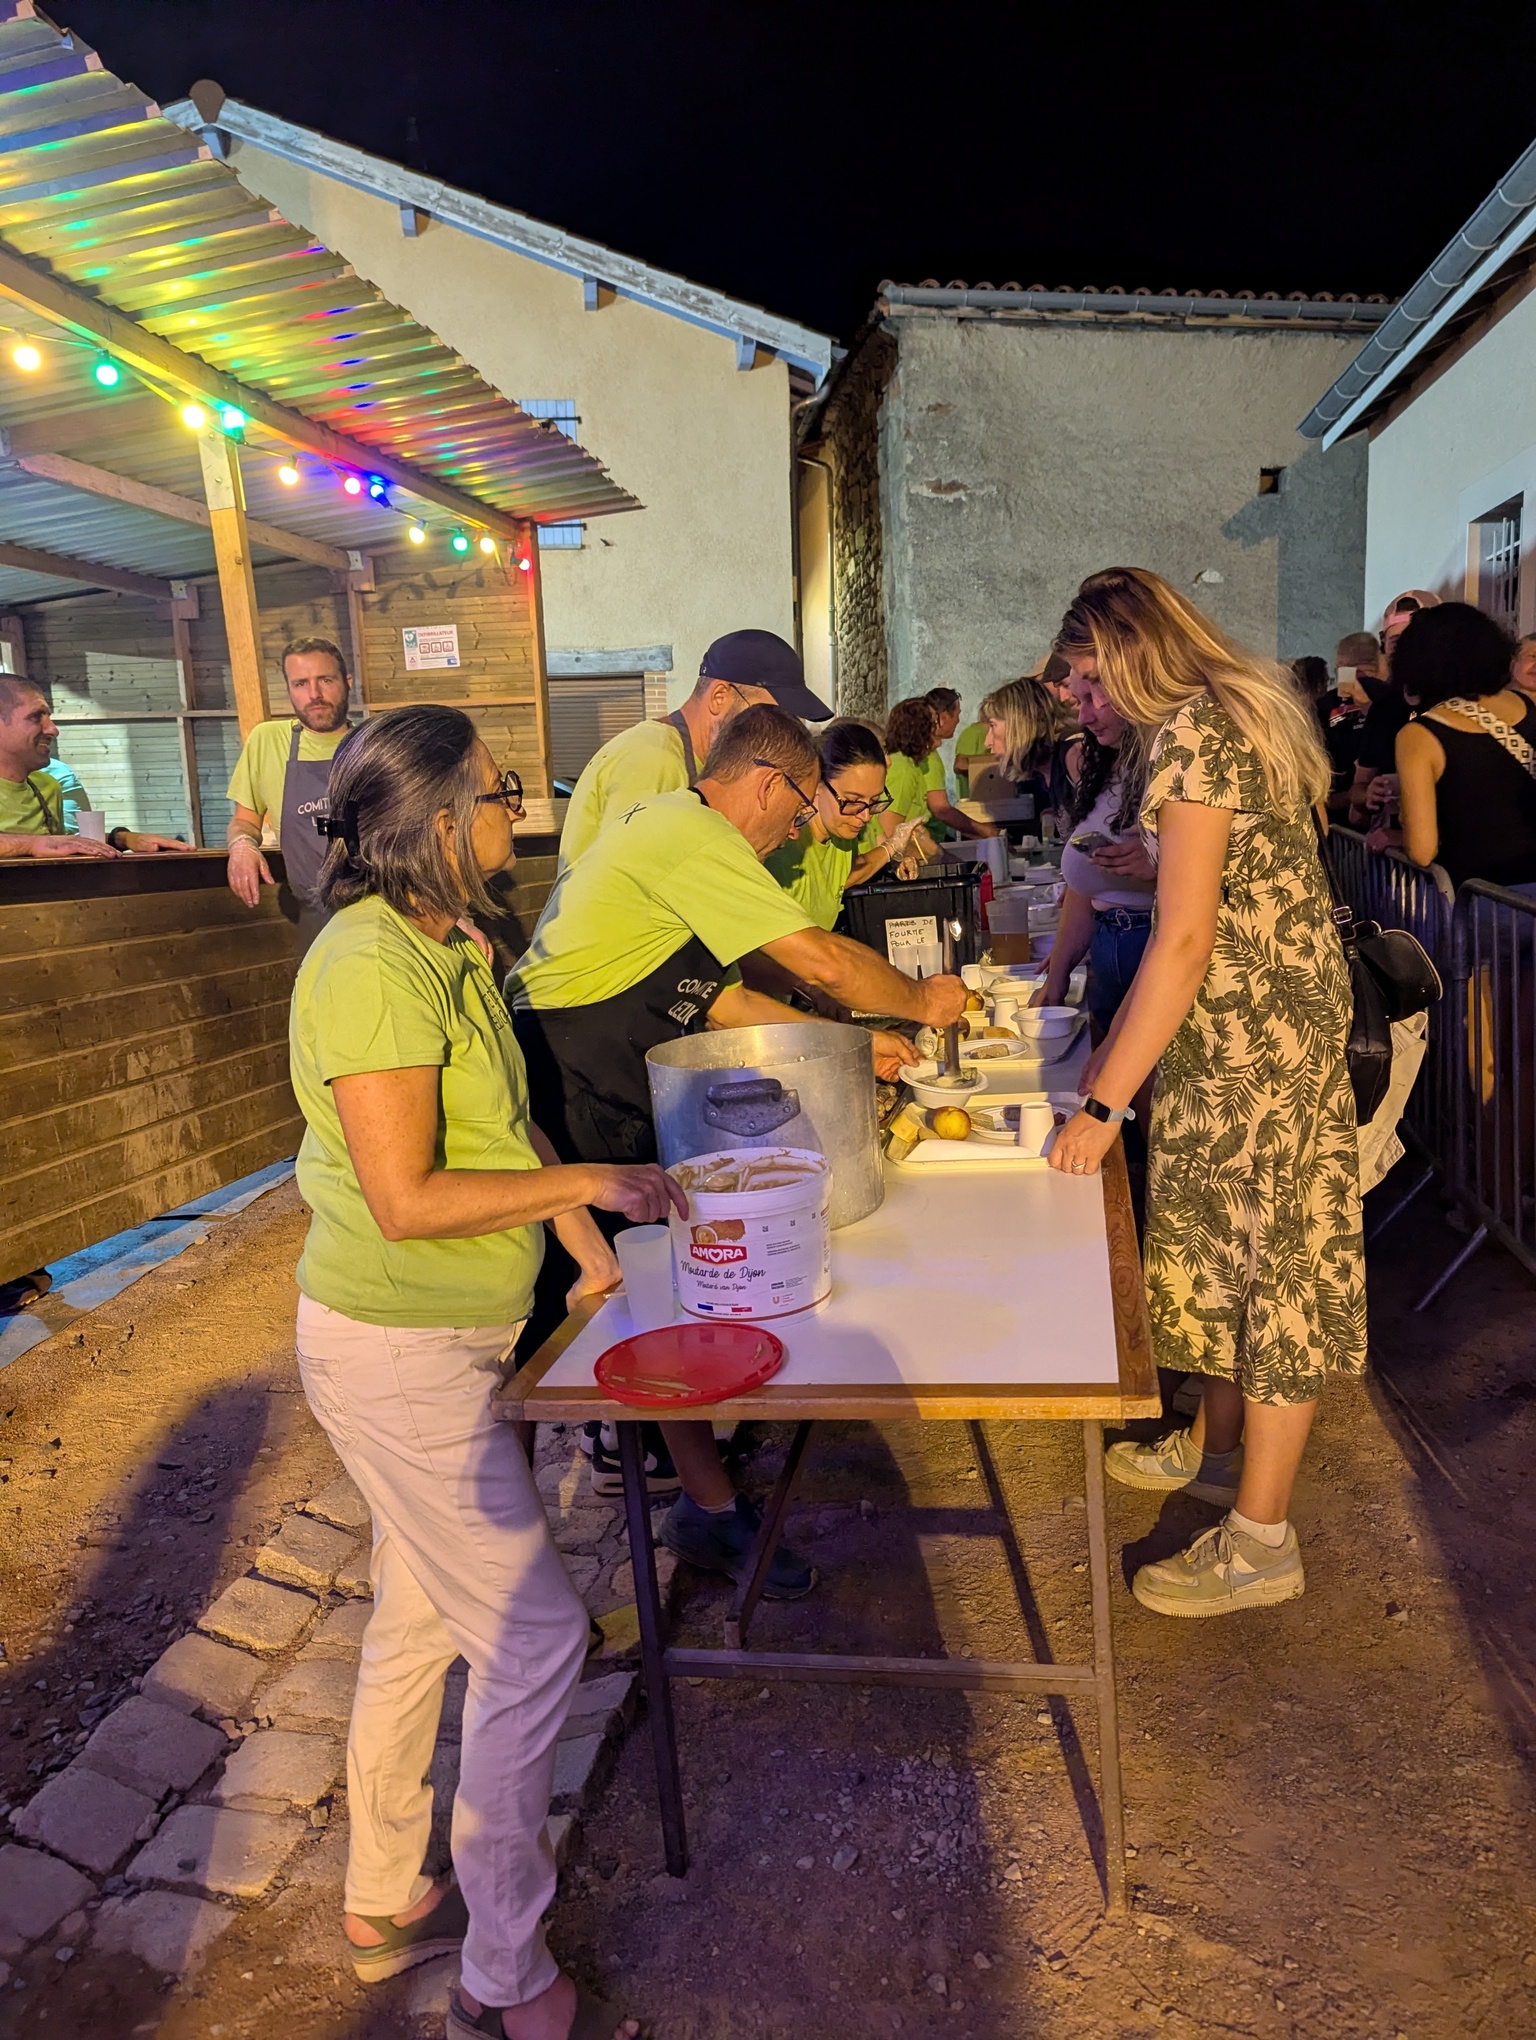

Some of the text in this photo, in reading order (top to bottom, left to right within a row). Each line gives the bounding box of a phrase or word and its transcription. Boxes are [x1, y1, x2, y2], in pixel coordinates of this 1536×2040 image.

[297, 797, 330, 815] COMIT
[889, 929, 924, 938] FOURME
[890, 940, 912, 948] POUR
[692, 1246, 744, 1263] AMORA
[680, 1260, 721, 1279] Moutarde
[723, 1268, 737, 1279] de
[739, 1266, 766, 1282] Dijon
[731, 1283, 747, 1292] Dijon
